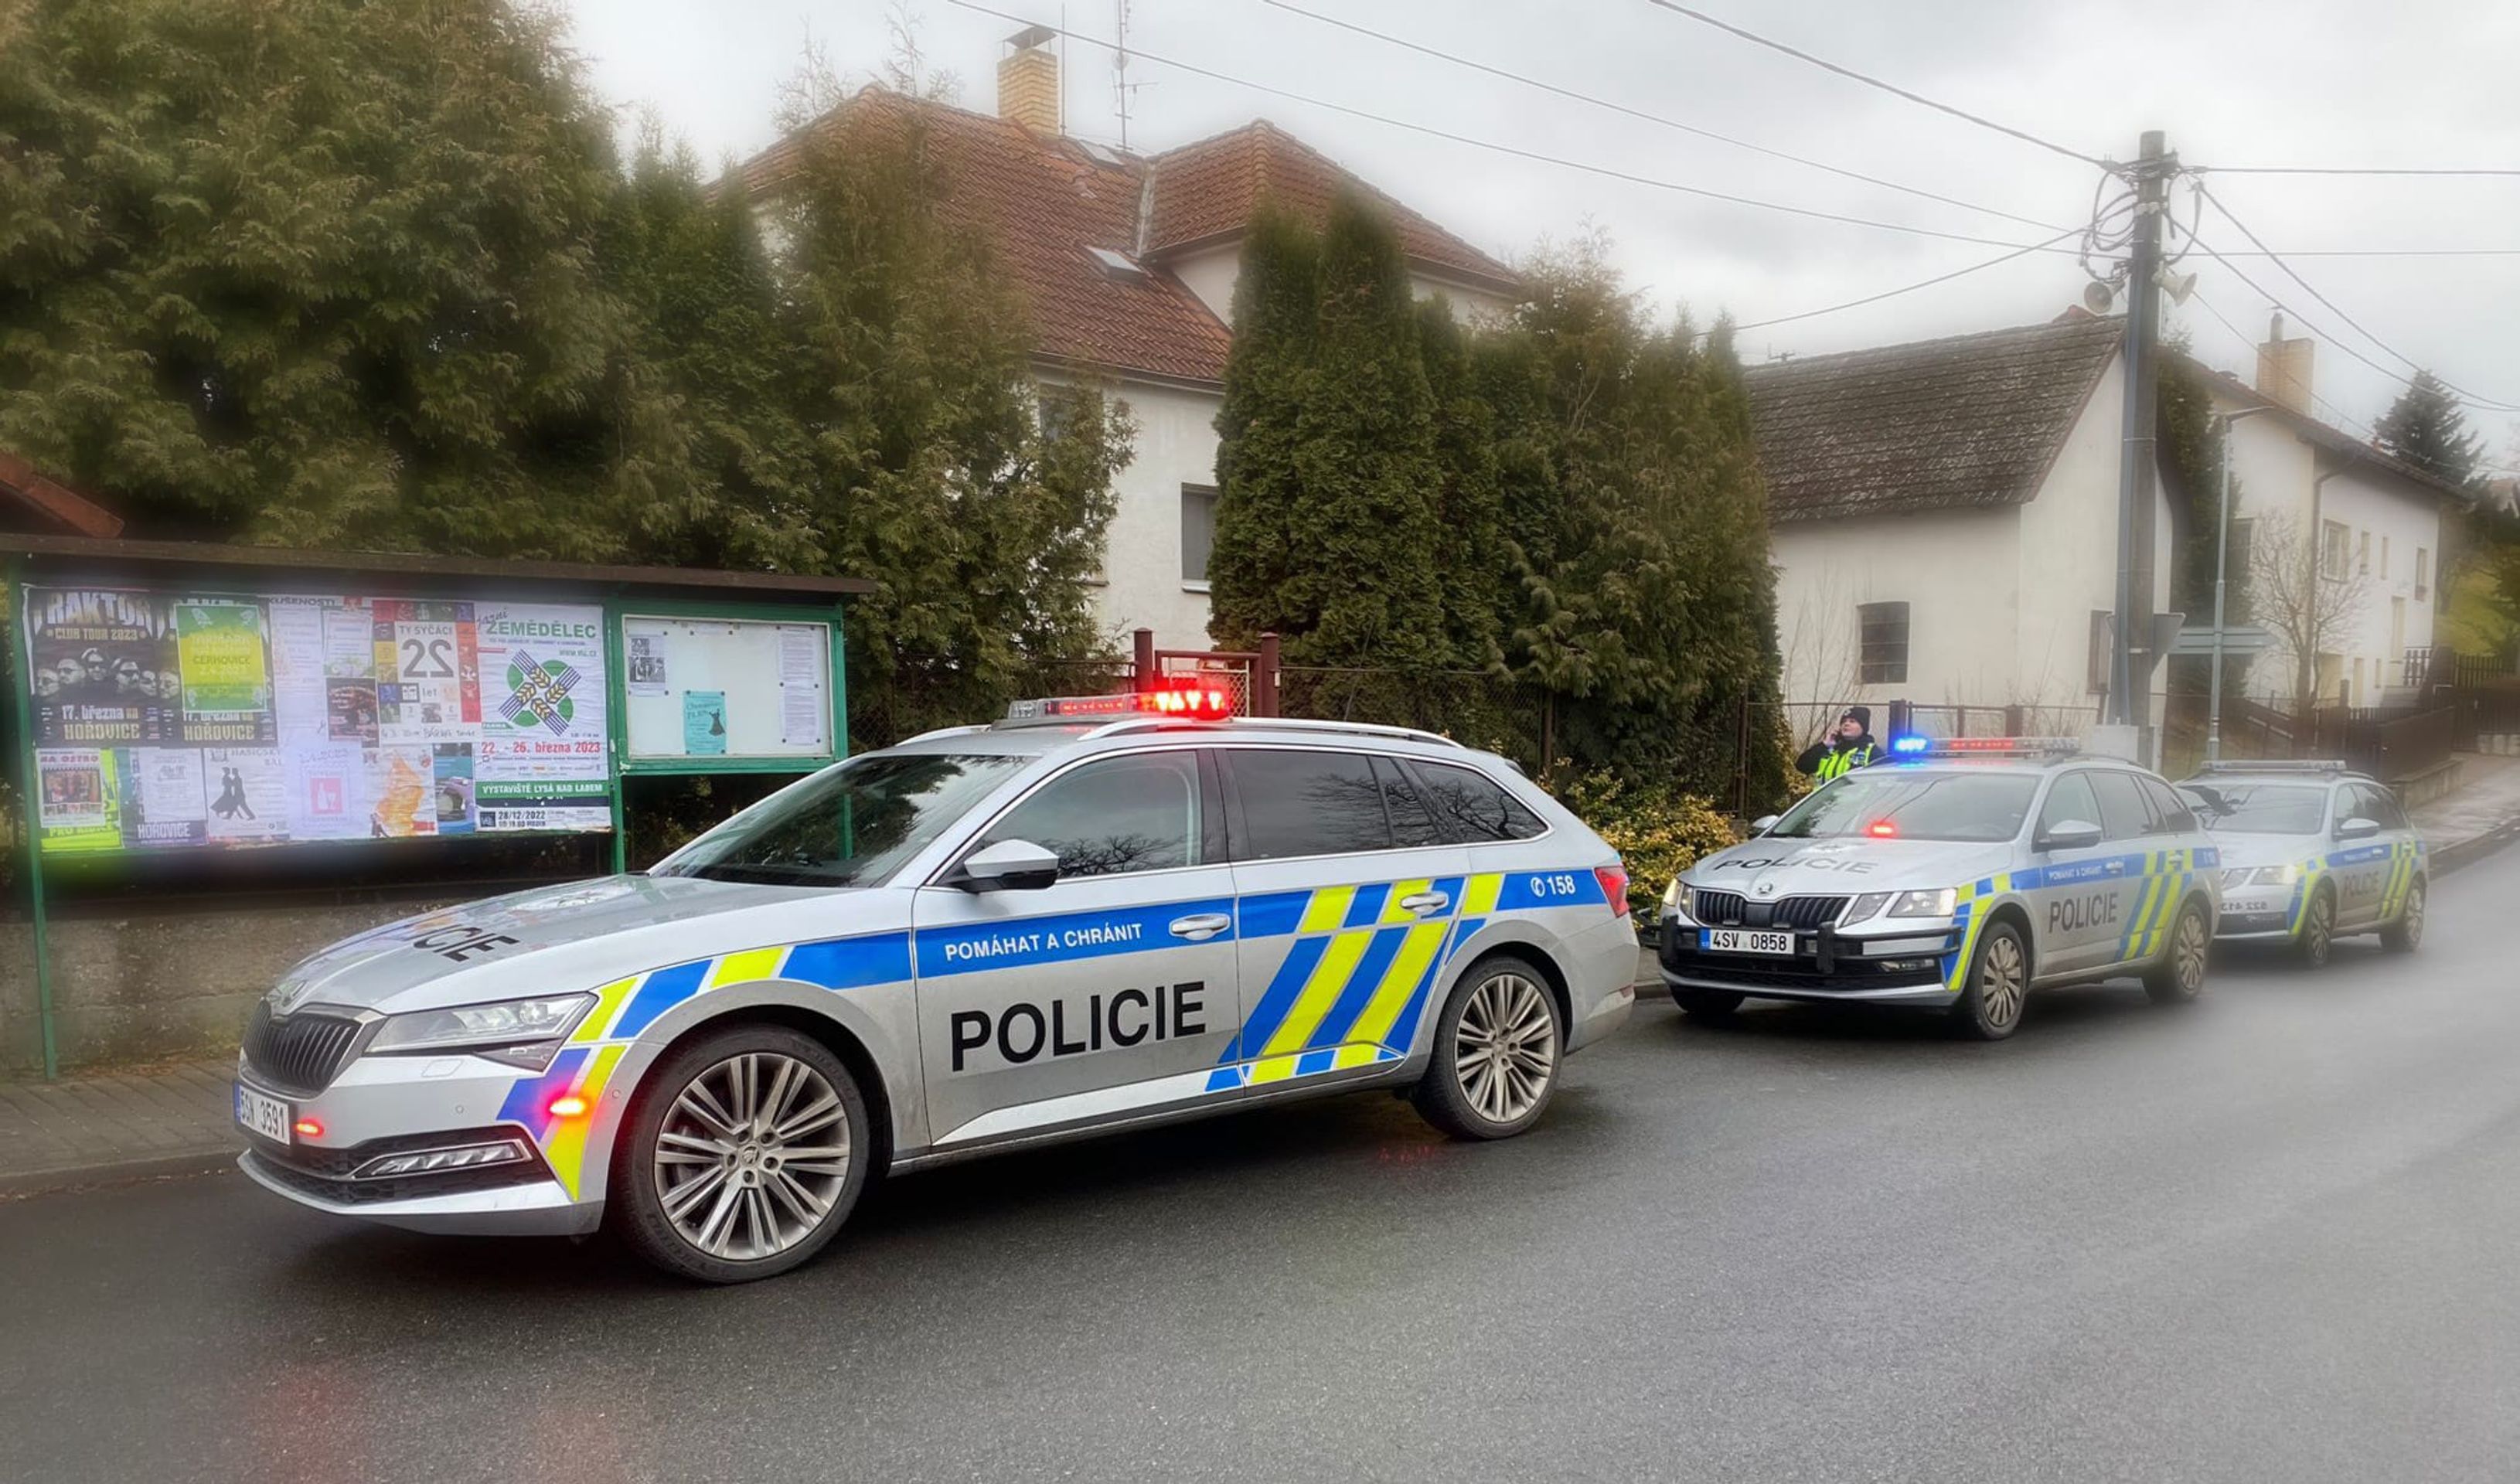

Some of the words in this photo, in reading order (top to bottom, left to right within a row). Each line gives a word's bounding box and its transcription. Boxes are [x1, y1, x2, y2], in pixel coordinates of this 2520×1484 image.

[55, 628, 80, 640] CLUB
[83, 628, 109, 641] TOUR
[111, 628, 138, 641] 2023
[400, 625, 410, 635] TY
[486, 619, 596, 638] ZEMĚDĚLEC
[81, 705, 124, 720] března
[63, 720, 140, 740] HOŘOVICE
[184, 723, 254, 740] HOŘOVICE
[482, 742, 499, 754] 22.
[513, 741, 530, 753] 26.
[535, 741, 571, 753] března
[575, 742, 601, 754] 2023
[1714, 856, 1878, 874] POLICIE
[1546, 875, 1576, 896] 158
[2048, 892, 2118, 934] POLICIE
[945, 934, 1040, 962] POMÁHAT
[1047, 934, 1061, 950] A
[1064, 922, 1143, 948] CHRÁNIT
[1713, 931, 1739, 948] 4SV
[1750, 934, 1787, 951] 0858
[950, 980, 1206, 1073] POLICIE
